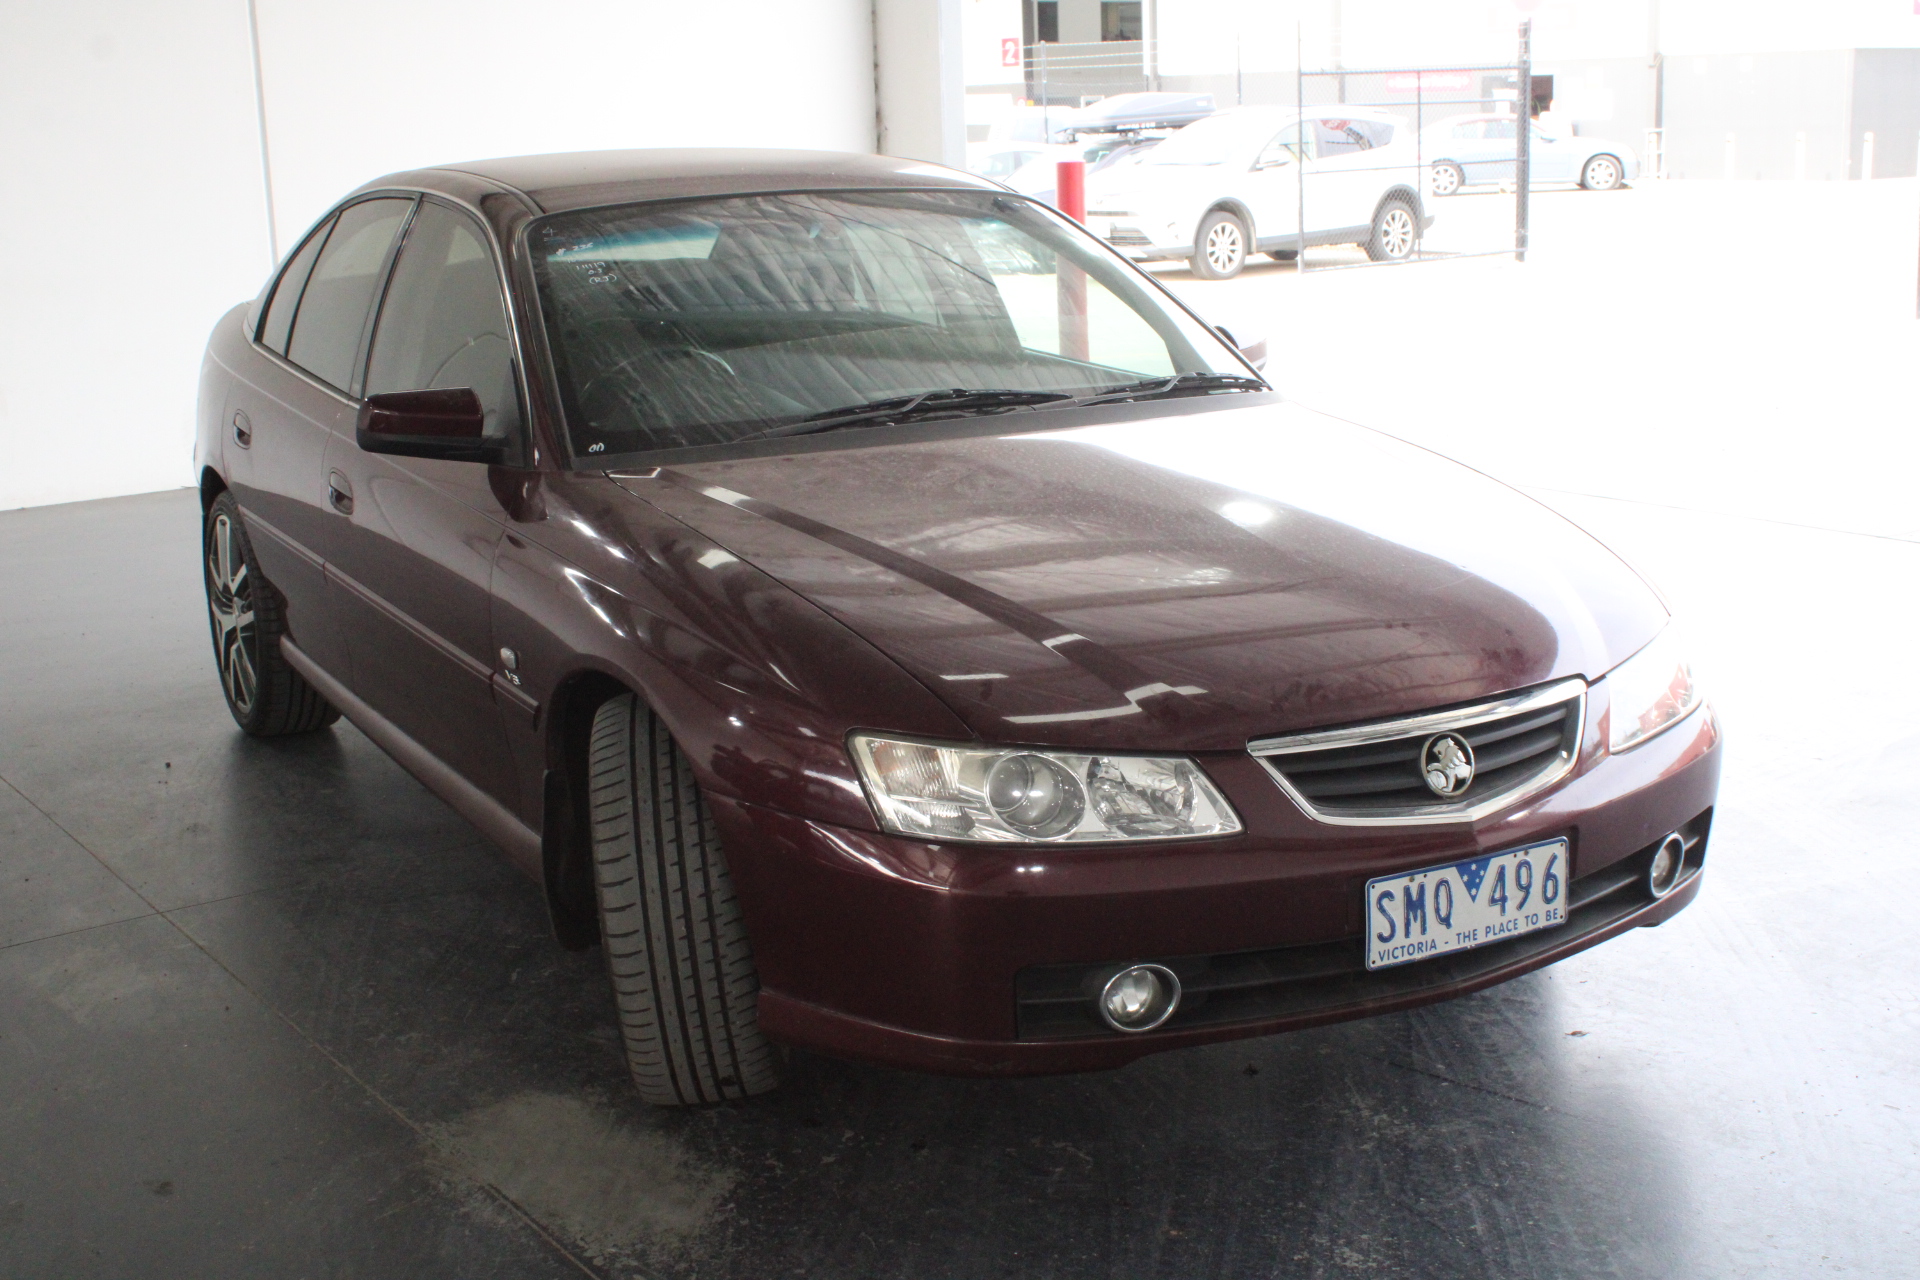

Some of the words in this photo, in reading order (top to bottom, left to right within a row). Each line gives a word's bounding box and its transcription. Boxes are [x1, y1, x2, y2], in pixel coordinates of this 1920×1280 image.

[1005, 41, 1016, 64] 2
[1376, 877, 1453, 943] SMQ
[1489, 852, 1559, 916] 496
[1378, 939, 1438, 962] VICTORIA
[1456, 929, 1478, 945] THE
[1485, 918, 1519, 938] PLACE
[1525, 913, 1539, 927] TO
[1545, 908, 1559, 922] BE
